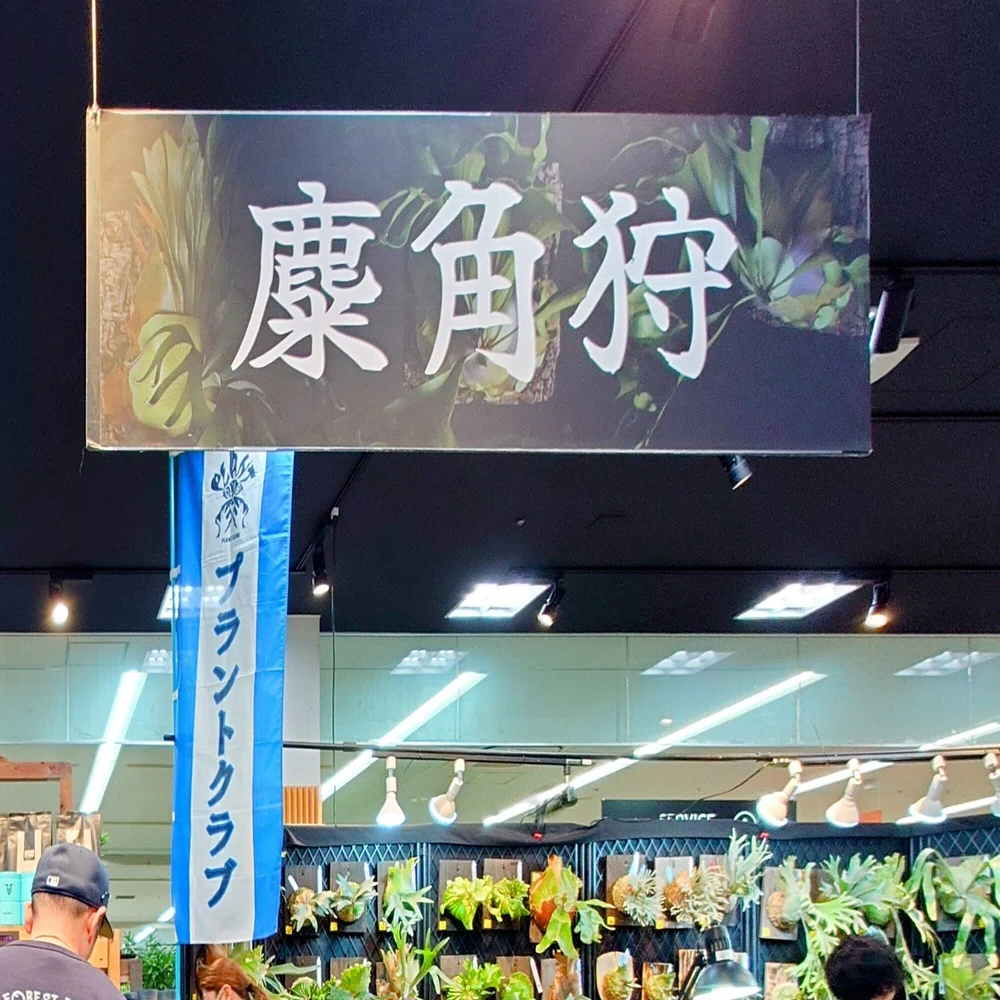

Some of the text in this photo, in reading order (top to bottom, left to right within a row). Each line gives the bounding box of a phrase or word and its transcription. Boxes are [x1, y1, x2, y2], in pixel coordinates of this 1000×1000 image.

[229, 180, 739, 383] 麋角狩
[204, 552, 244, 909] プラントクラブ
